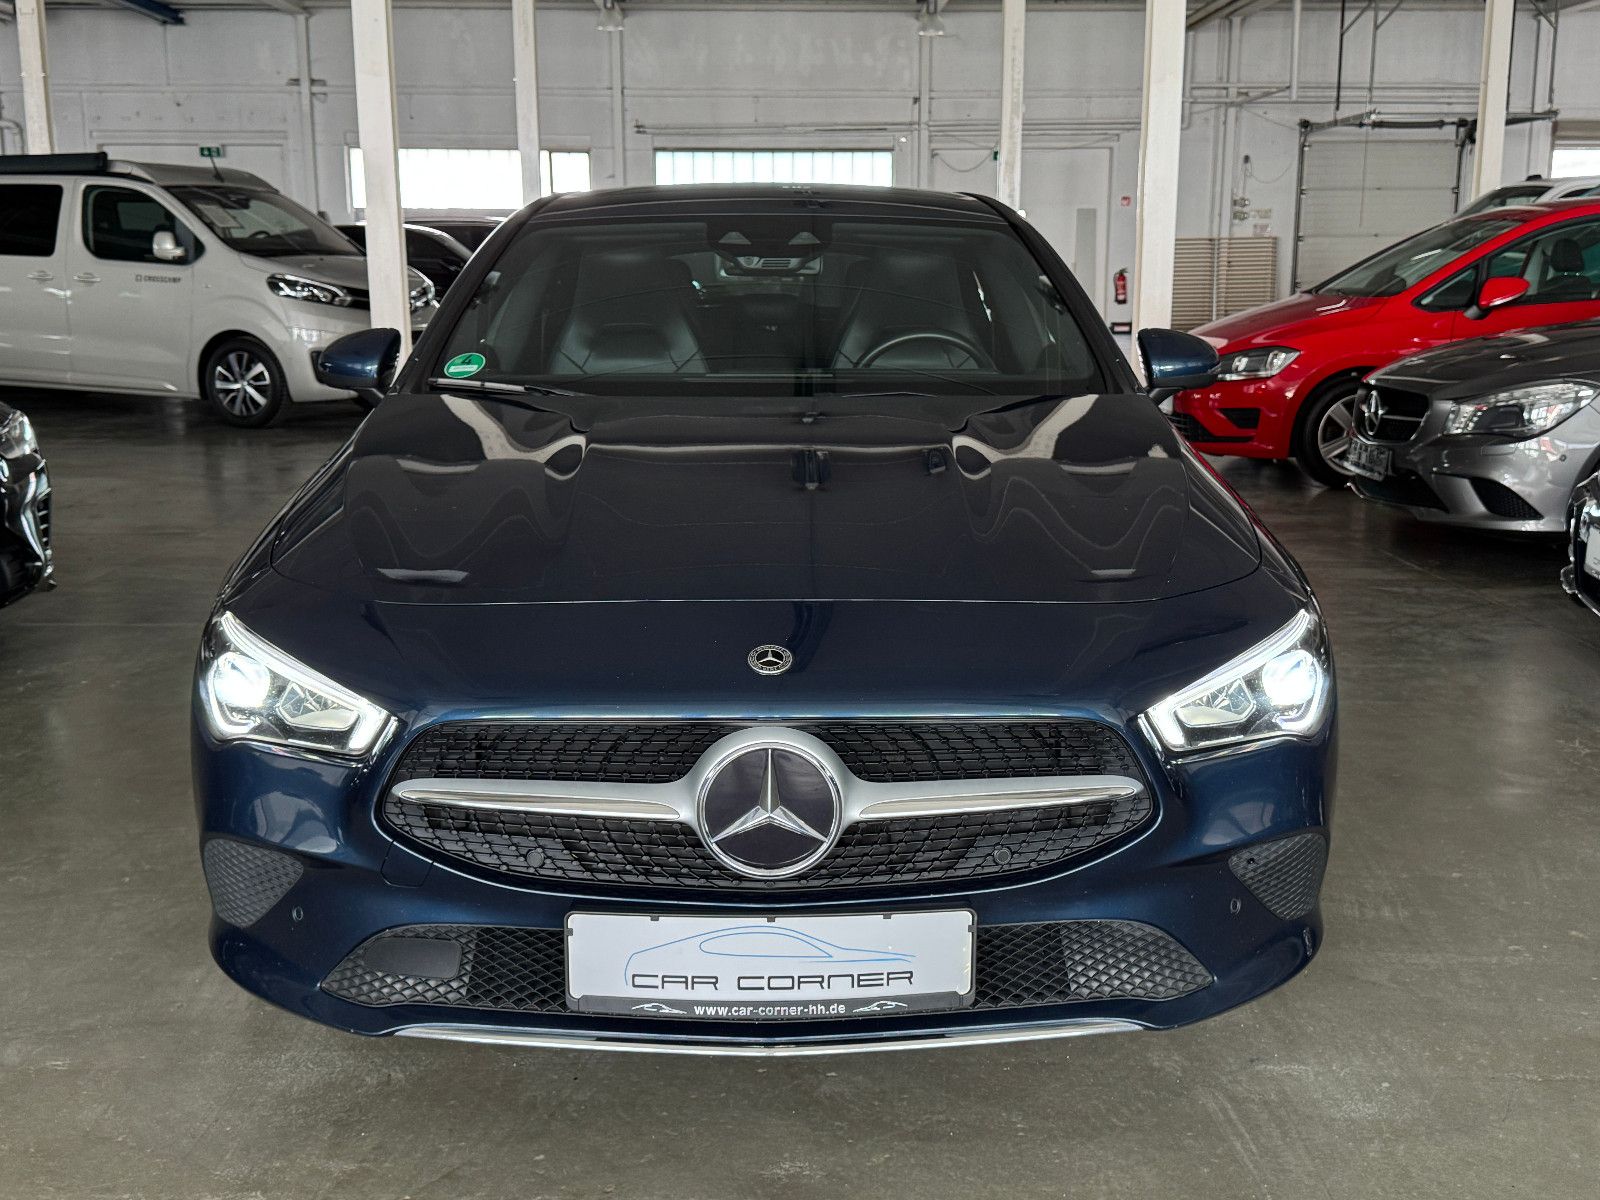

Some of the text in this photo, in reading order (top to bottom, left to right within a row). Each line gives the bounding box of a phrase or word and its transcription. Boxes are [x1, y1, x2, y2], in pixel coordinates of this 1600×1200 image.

[461, 354, 473, 365] 4
[631, 970, 914, 991] CAR CORNER
[693, 1003, 846, 1017] www.car-corner-hh.de
